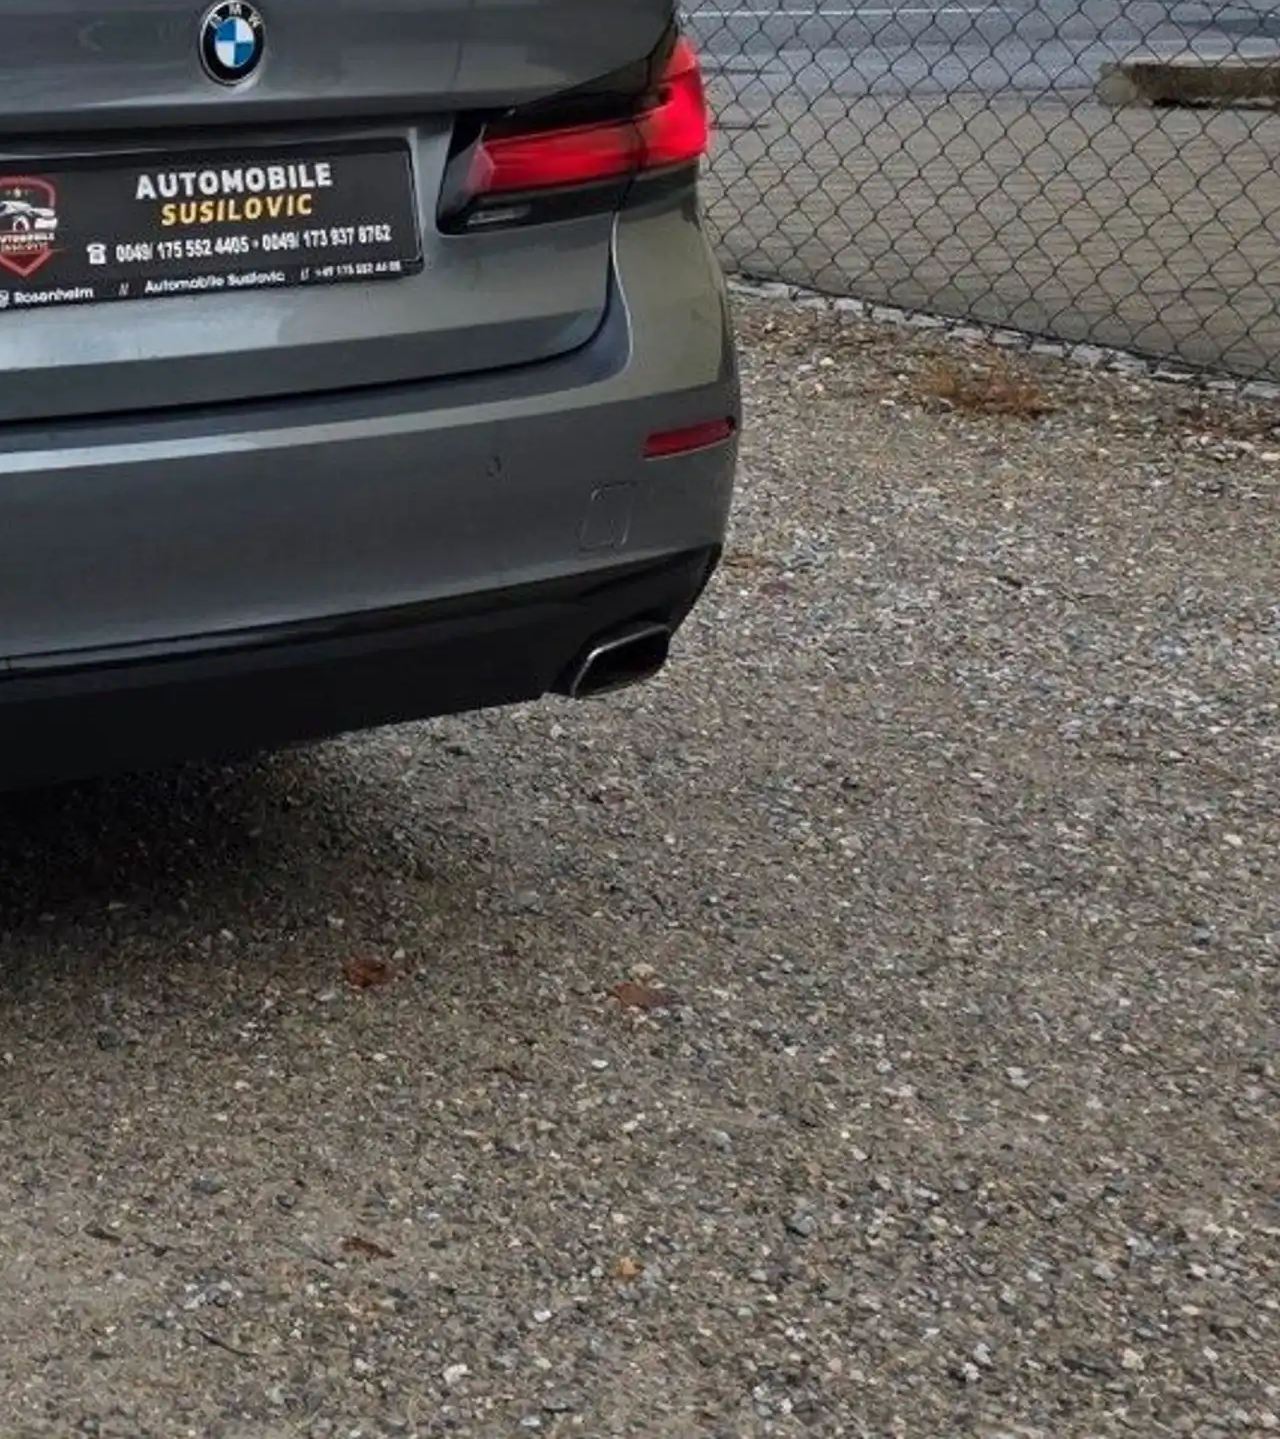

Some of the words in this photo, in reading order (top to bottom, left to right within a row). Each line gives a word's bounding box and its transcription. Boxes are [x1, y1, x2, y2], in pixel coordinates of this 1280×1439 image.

[135, 162, 334, 200] AUTOMOBILE
[160, 193, 313, 227] SUSILOVIC
[157, 240, 183, 260] 175
[185, 238, 213, 258] 552
[214, 235, 250, 254] 4405
[303, 228, 329, 248] 173
[330, 226, 355, 246] 937
[358, 223, 393, 244] 8762
[13, 286, 95, 304] Rosenheim
[144, 275, 225, 294] Automobile
[227, 270, 286, 286] Susilovic
